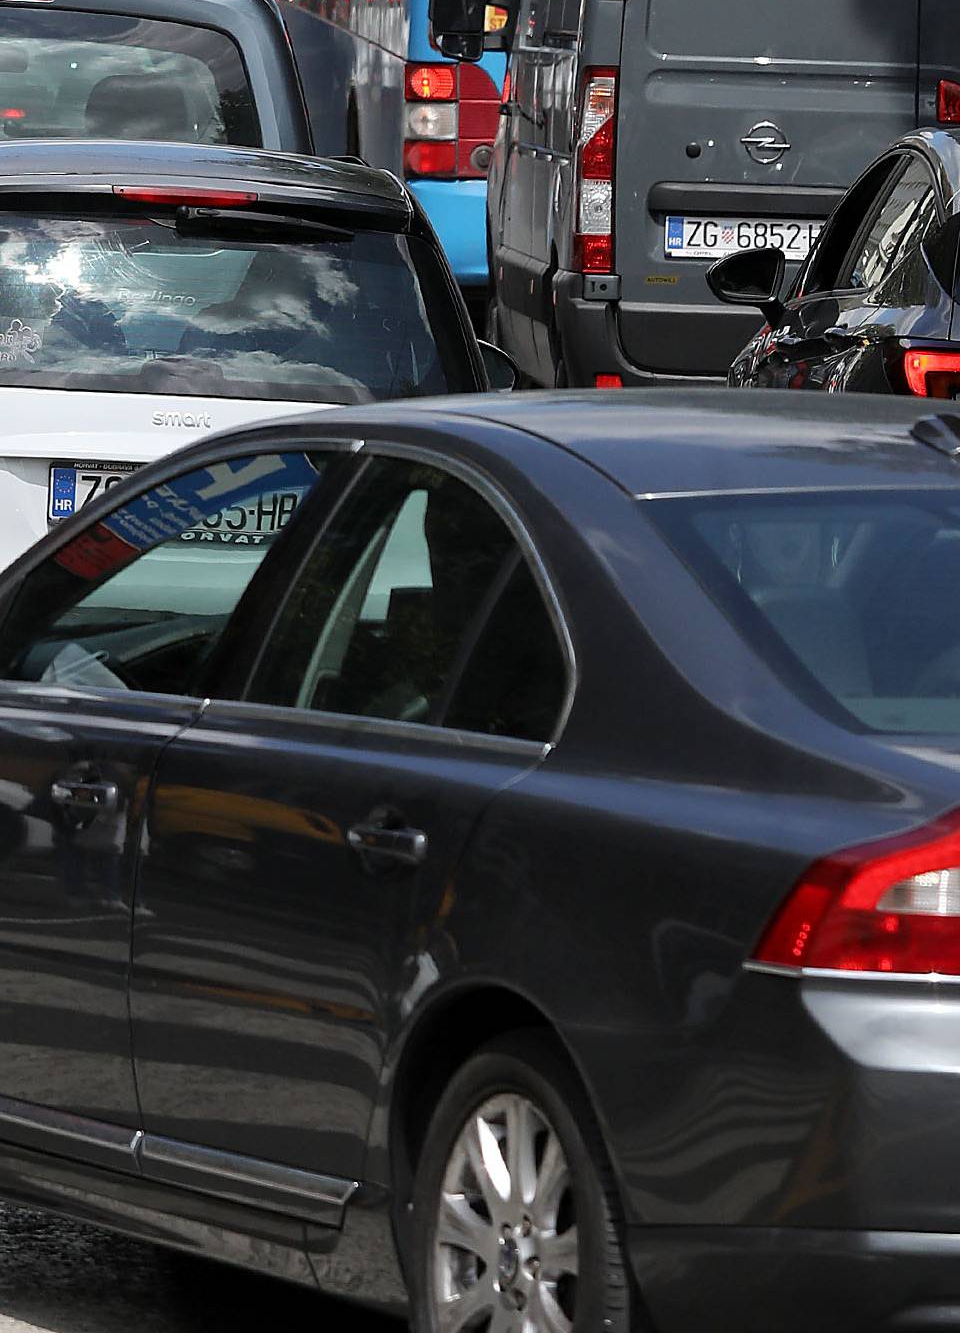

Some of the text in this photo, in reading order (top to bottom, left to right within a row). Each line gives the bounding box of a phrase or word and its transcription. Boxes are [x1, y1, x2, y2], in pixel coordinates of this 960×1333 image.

[687, 221, 718, 248] ZG
[668, 237, 681, 247] HR
[152, 411, 211, 428] smart
[55, 499, 72, 511] HR
